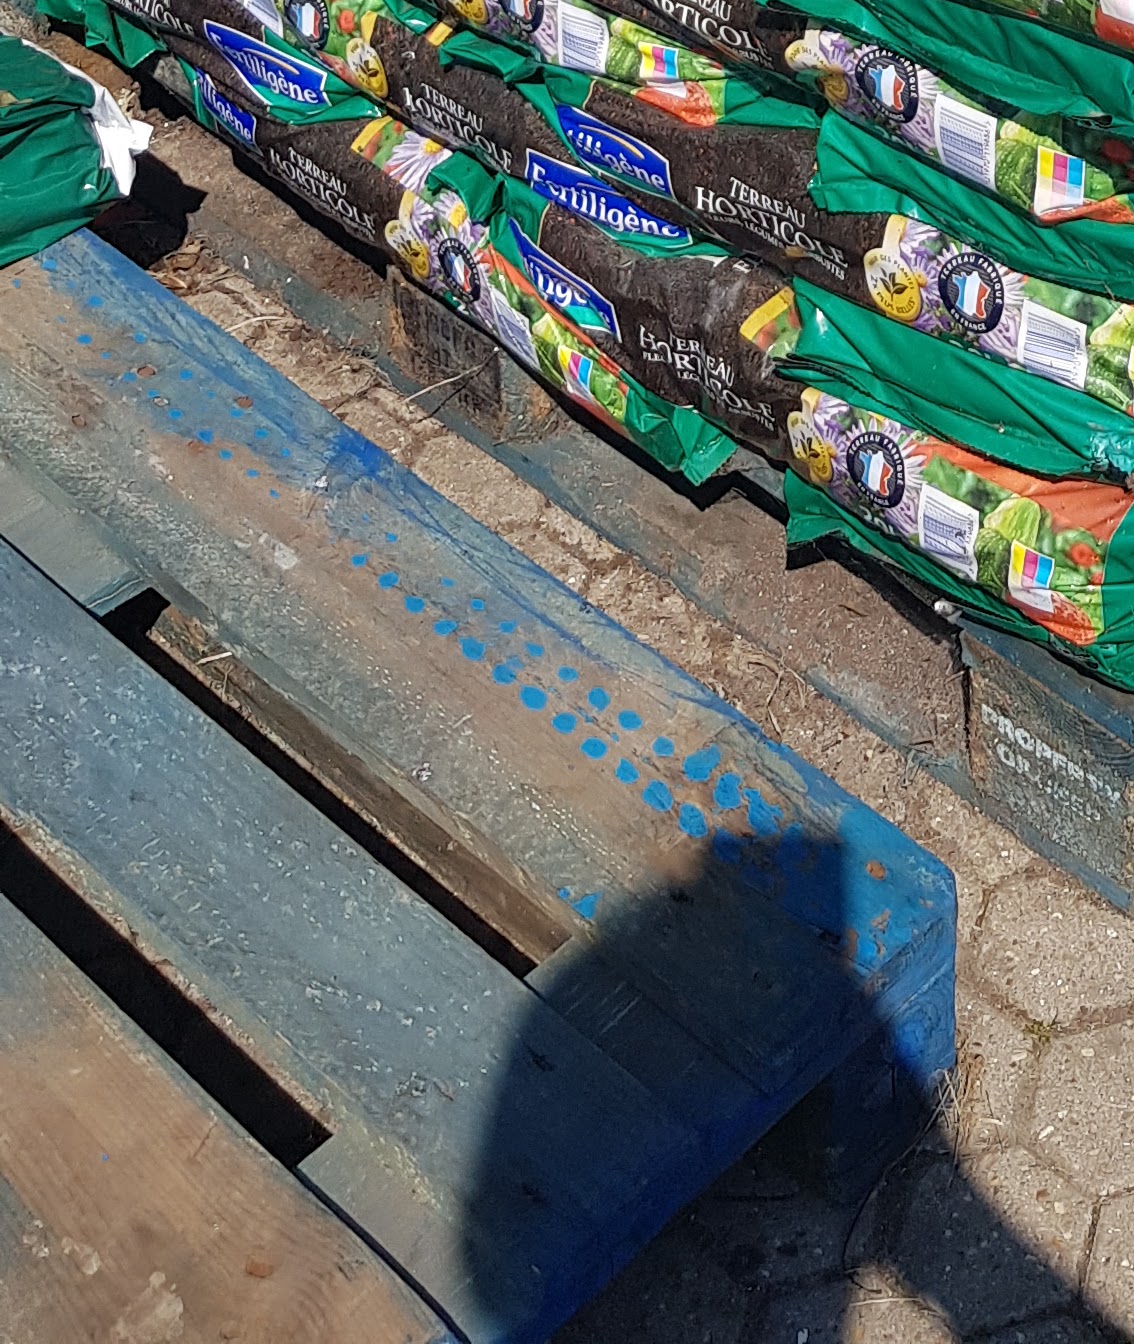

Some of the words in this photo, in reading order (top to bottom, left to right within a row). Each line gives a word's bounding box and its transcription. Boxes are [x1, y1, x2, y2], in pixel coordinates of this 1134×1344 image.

[420, 82, 483, 133] TERREAU
[269, 145, 376, 241] HORTICOLE
[288, 145, 348, 197] TERREAU
[695, 185, 850, 269] HORTICOLE
[730, 176, 807, 229] TERREAU
[938, 252, 977, 283] TERREAU
[977, 254, 1004, 305] FABRIQUE
